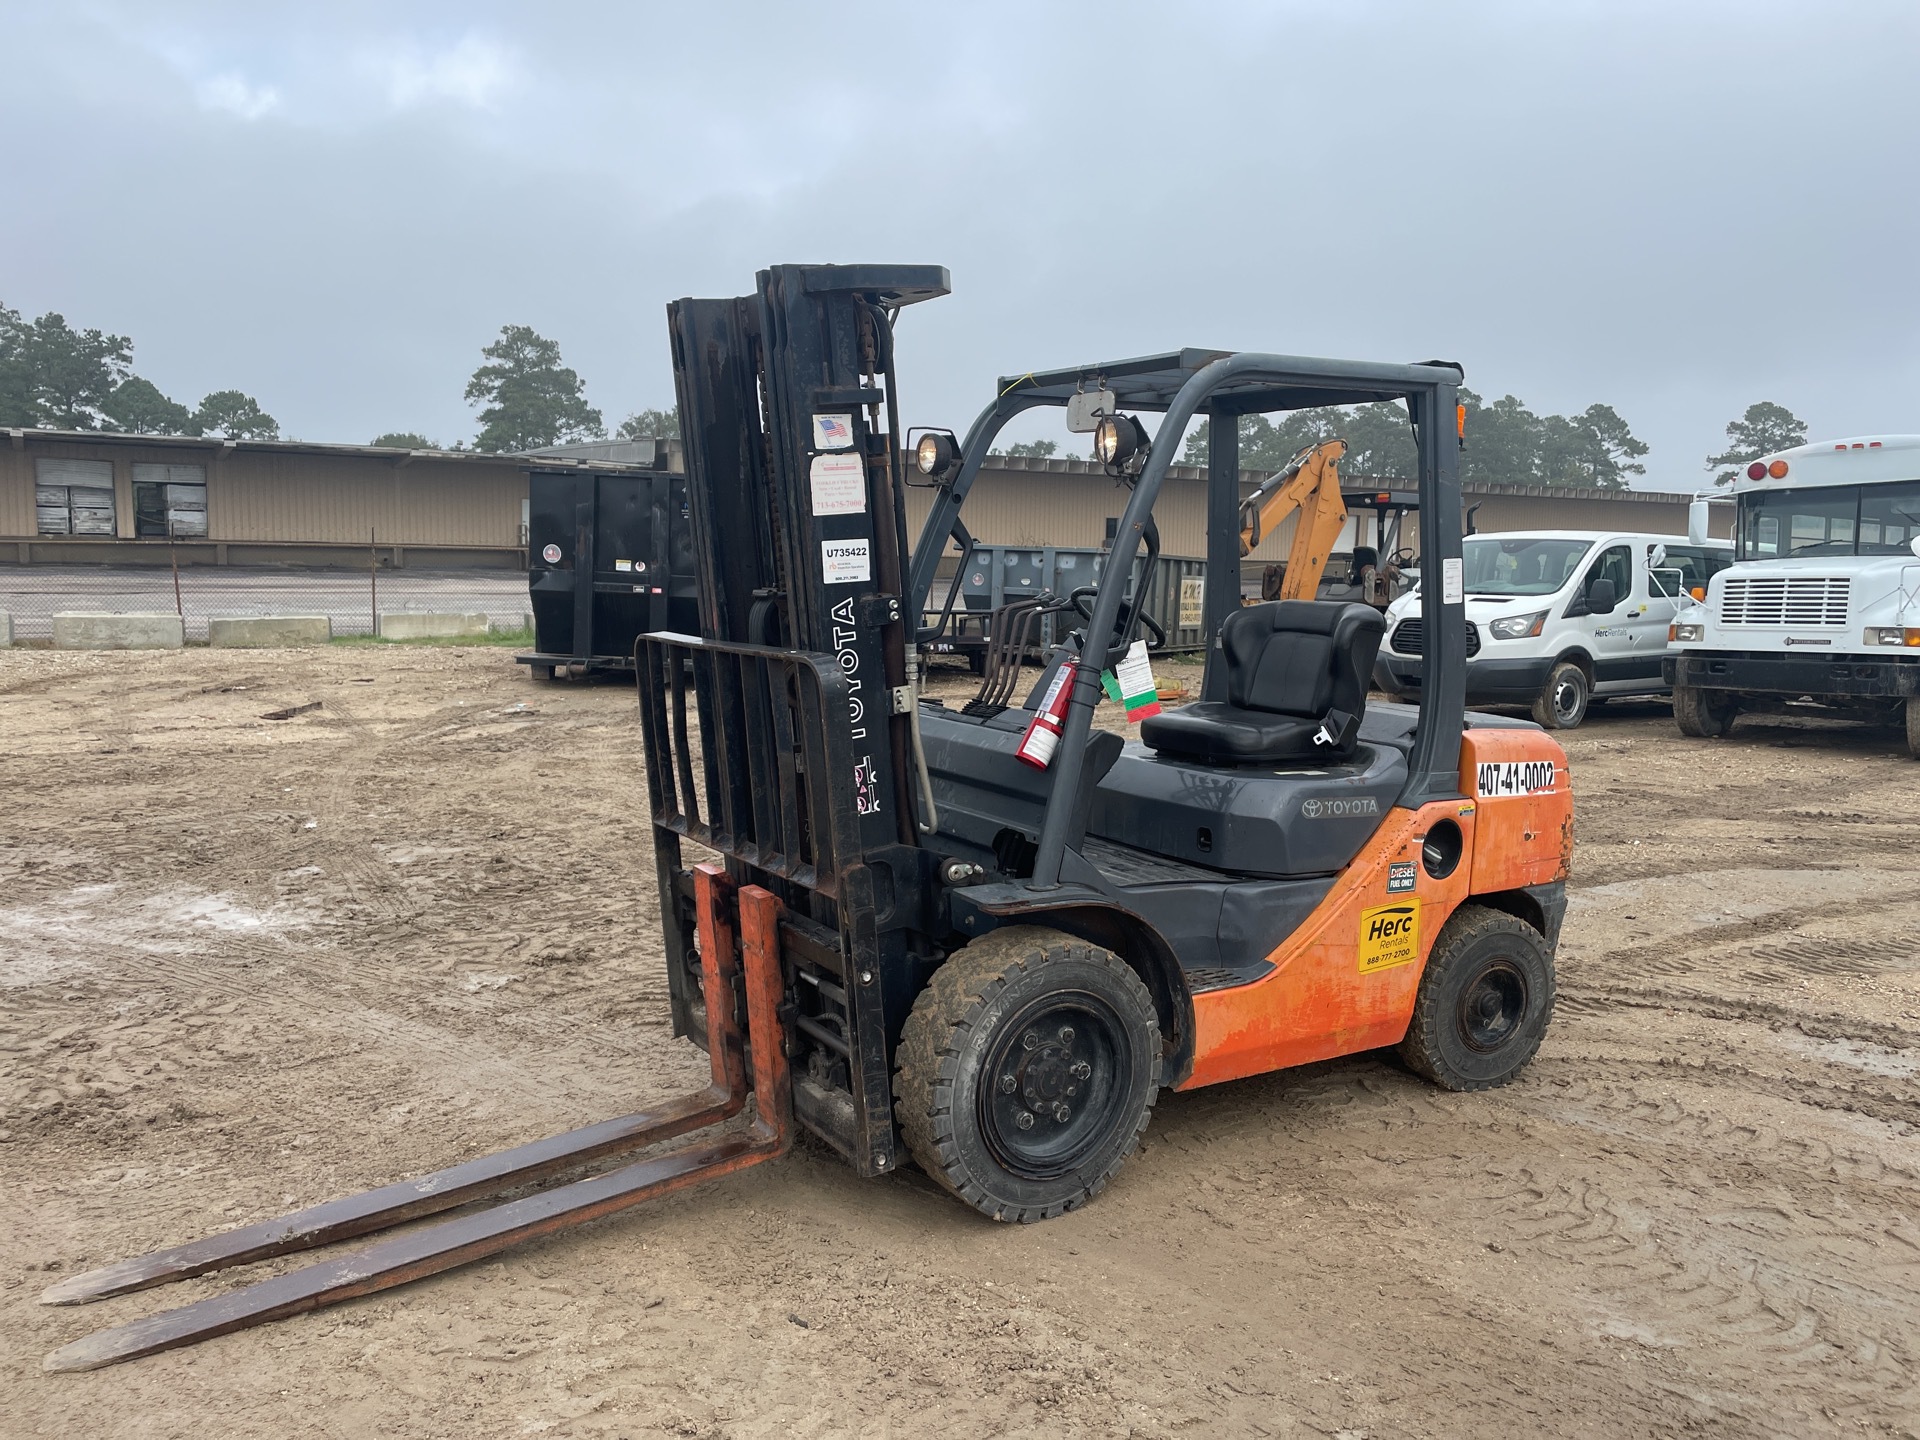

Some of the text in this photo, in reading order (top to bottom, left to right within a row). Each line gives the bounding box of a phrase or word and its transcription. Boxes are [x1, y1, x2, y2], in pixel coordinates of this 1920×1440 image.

[826, 547, 867, 558] U735422
[1478, 762, 1554, 795] 407-41-0002
[1324, 800, 1378, 815] TOYOTA
[1390, 867, 1415, 879] DIESEL
[1389, 878, 1413, 888] FUEL ONLY
[1368, 916, 1413, 942] Herc
[1379, 935, 1409, 950] Rentals
